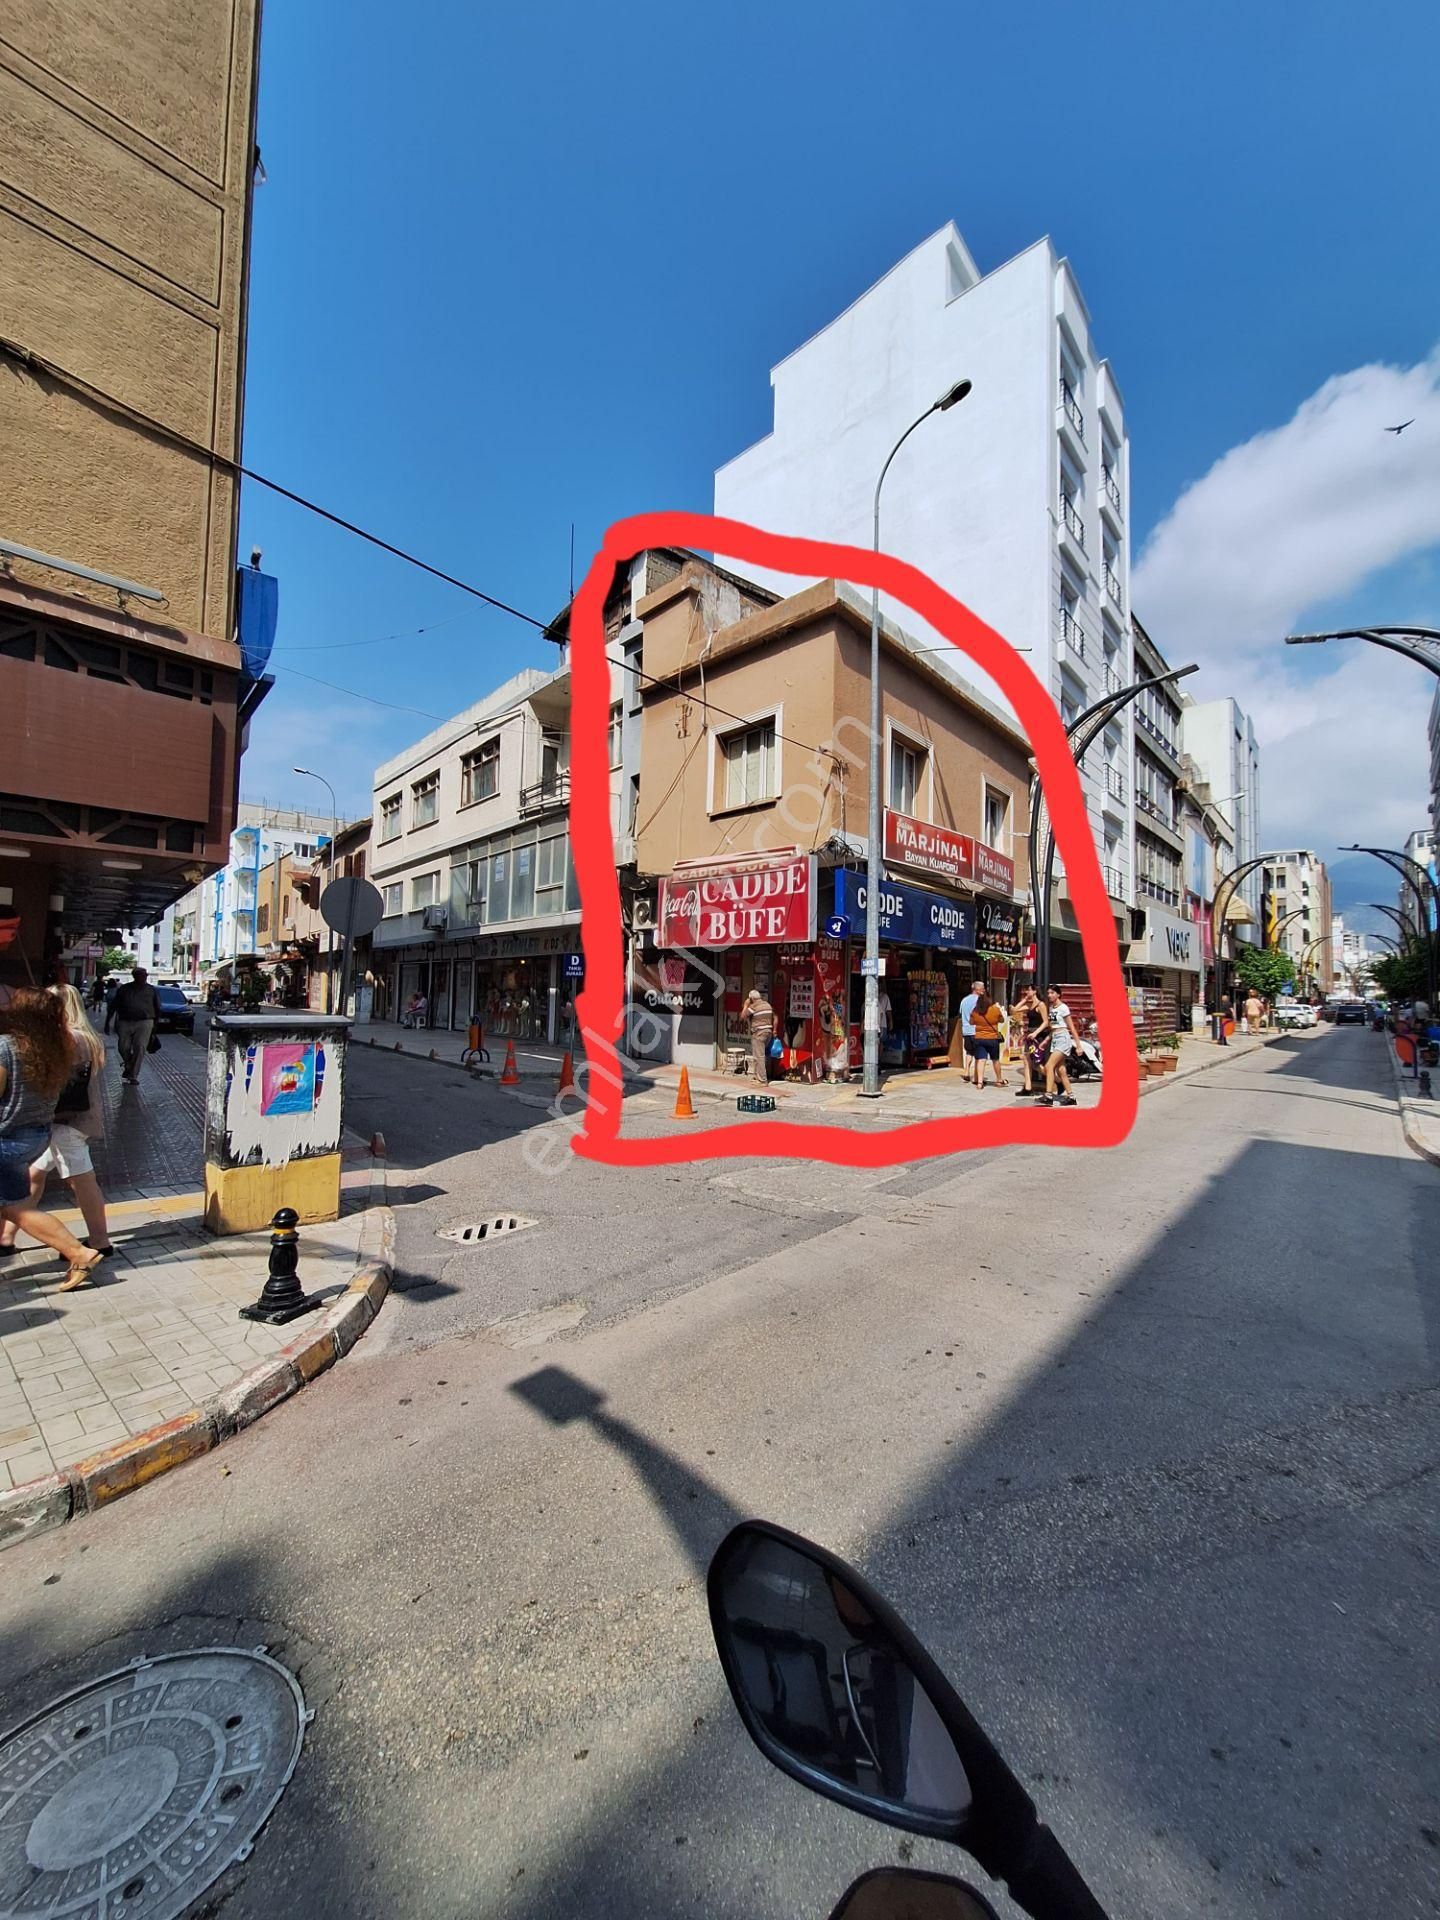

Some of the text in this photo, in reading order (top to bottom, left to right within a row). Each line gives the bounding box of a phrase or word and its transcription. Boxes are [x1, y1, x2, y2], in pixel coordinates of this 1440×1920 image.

[896, 827, 967, 862] MARJİNAL
[702, 863, 806, 903] CADDE
[857, 887, 903, 917] CDDE
[709, 903, 786, 940] BÜFE
[930, 904, 965, 930] CADDE
[818, 937, 842, 950] CADDE
[941, 927, 955, 940] BÜFE
[777, 943, 810, 954] CADDE
[821, 948, 839, 960] BÜFE
[571, 955, 580, 966] D
[644, 989, 703, 1009] Butterfly
